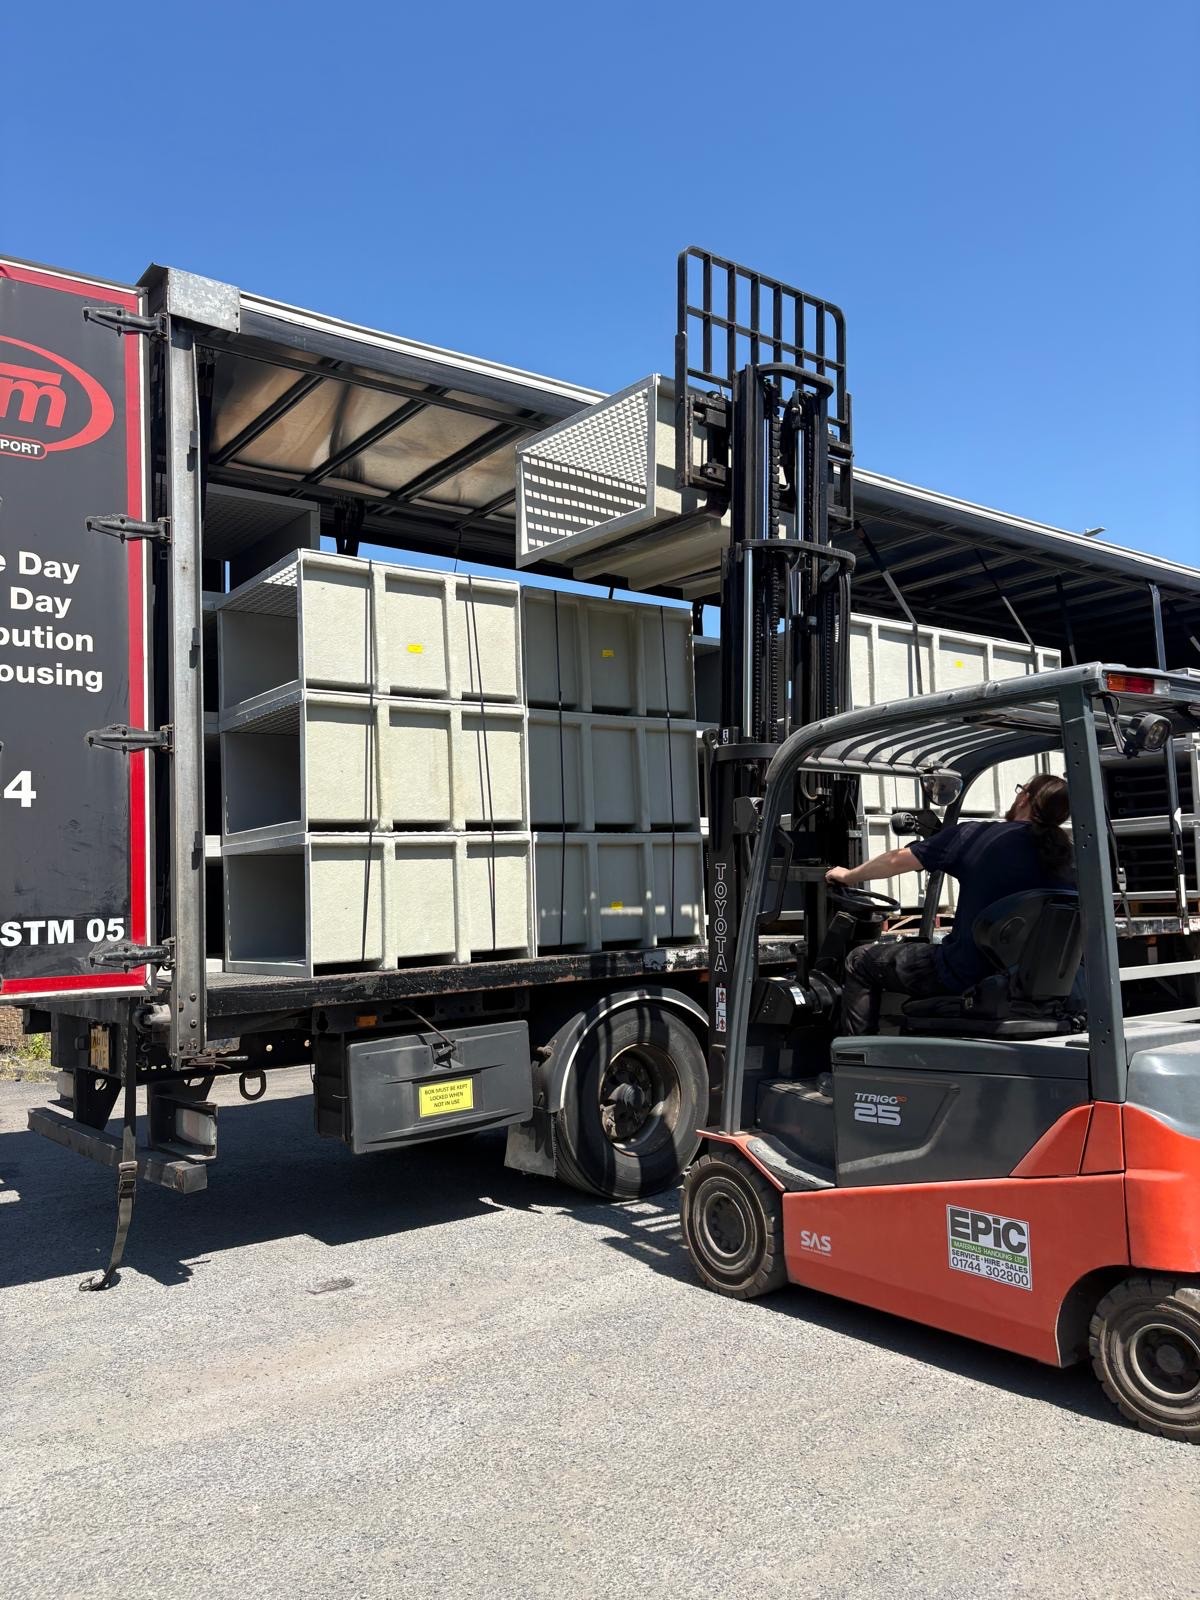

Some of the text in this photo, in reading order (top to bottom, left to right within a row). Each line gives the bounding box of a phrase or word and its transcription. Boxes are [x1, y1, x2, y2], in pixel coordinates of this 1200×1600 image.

[0, 438, 41, 455] PORT
[18, 550, 80, 585] Day
[10, 586, 72, 619] Day
[0, 662, 103, 693] ousing
[3, 770, 37, 808] 4
[714, 862, 728, 973] TOYOTA
[0, 918, 125, 947] STM 05
[853, 1102, 901, 1126] 25
[800, 1229, 832, 1252] SAS
[953, 1240, 1025, 1264] MATERIALS HANDLING LTD
[951, 1256, 1028, 1286] 01744 302800
[952, 1249, 1028, 1274] SERVICE HIRE SALES
